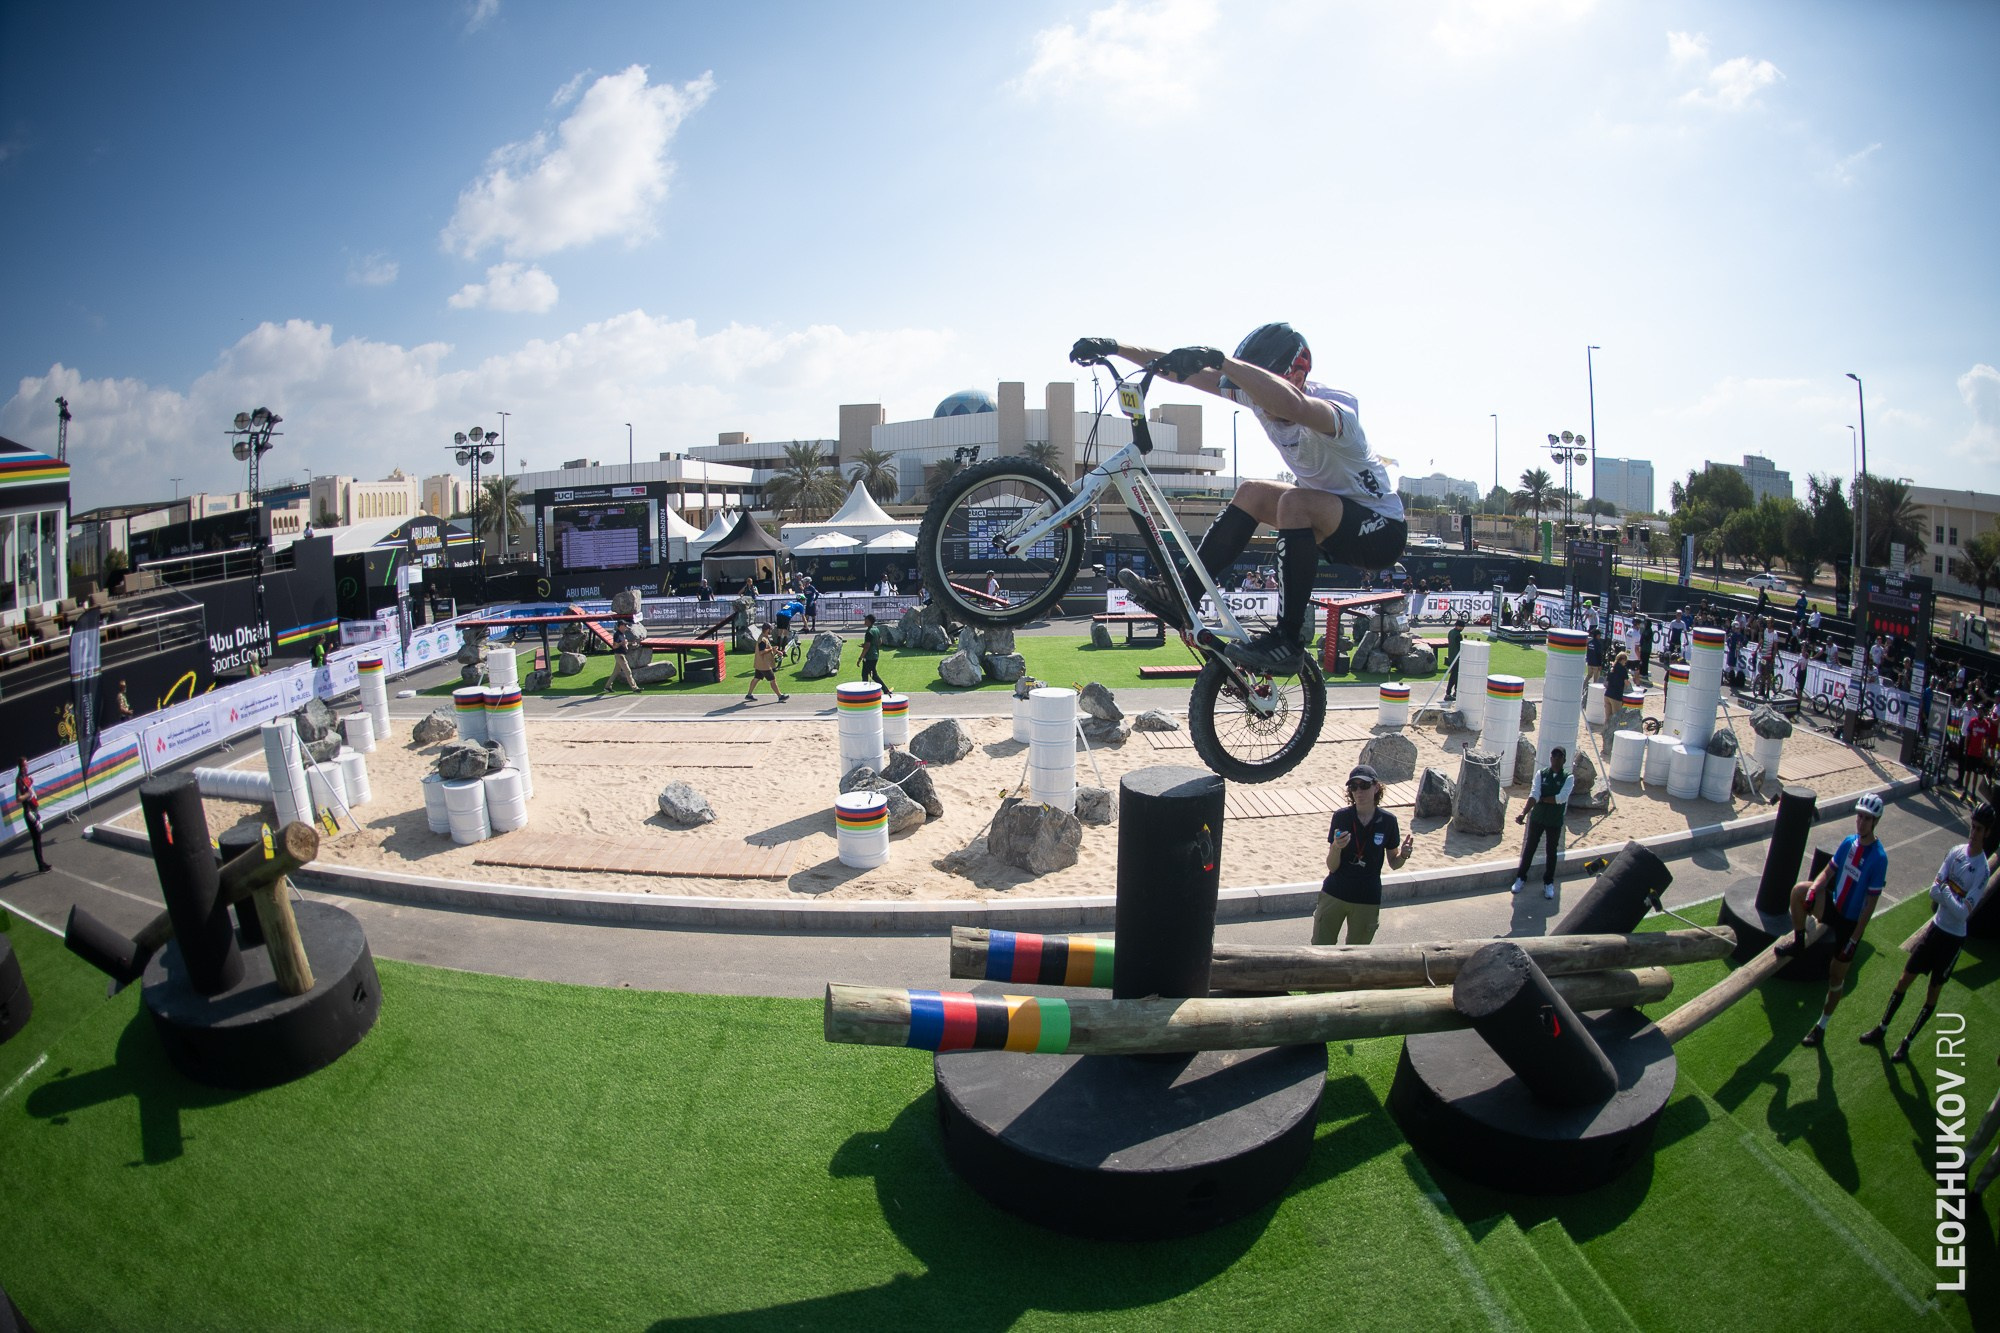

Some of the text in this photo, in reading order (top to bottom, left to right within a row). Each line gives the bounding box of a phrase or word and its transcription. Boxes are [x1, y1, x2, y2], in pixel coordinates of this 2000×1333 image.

[1131, 485, 1164, 546] DOMINIK OSWALD
[411, 525, 438, 540] ABU DHABI
[566, 586, 600, 598] ABU DHABI
[1448, 598, 1492, 611] TISSO
[209, 632, 234, 653] Abu
